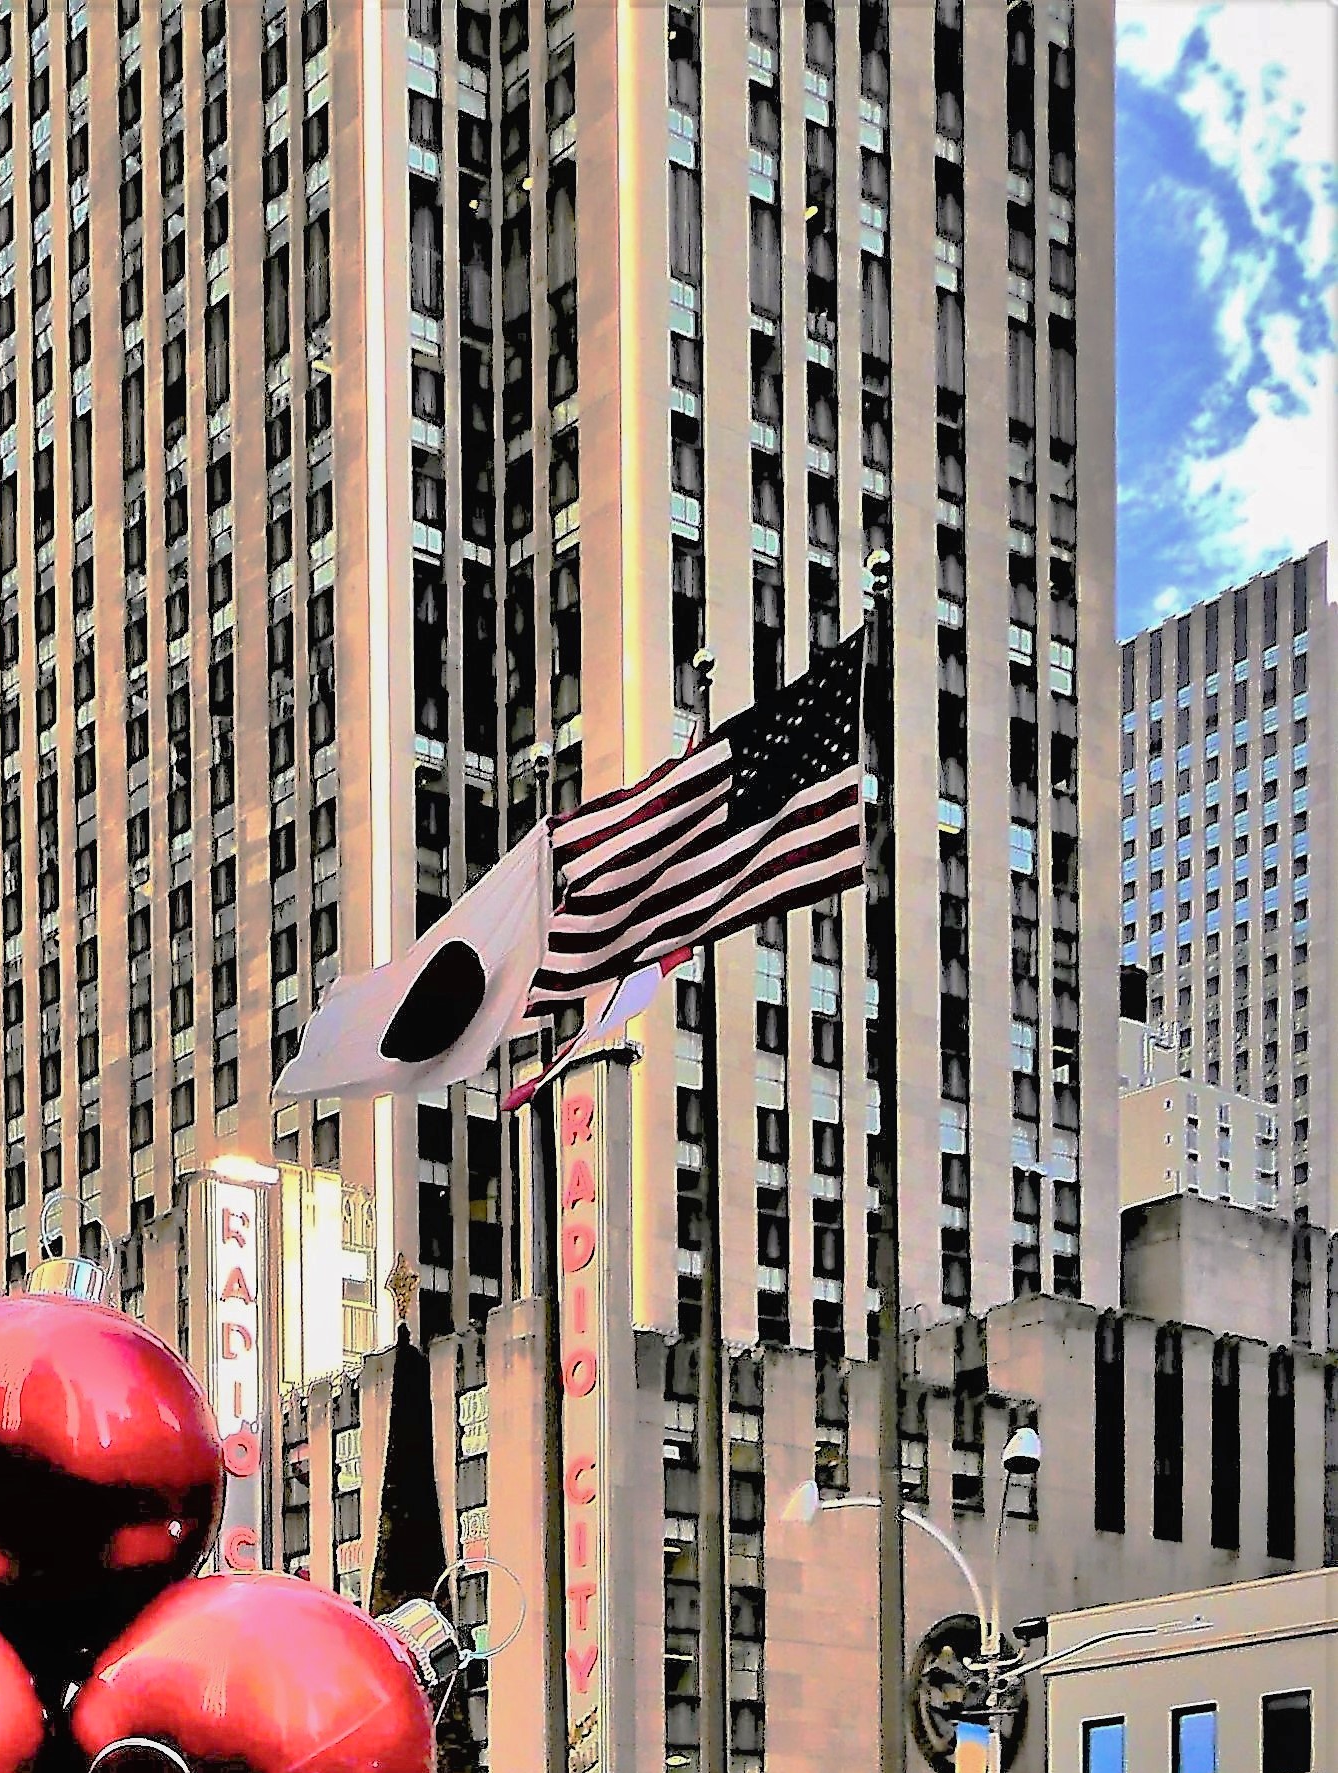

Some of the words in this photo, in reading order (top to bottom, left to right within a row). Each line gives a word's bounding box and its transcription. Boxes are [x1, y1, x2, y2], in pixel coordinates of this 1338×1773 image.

[220, 1206, 260, 1477] RADIO
[561, 1093, 597, 1399] RADIO
[564, 1456, 599, 1695] CITY
